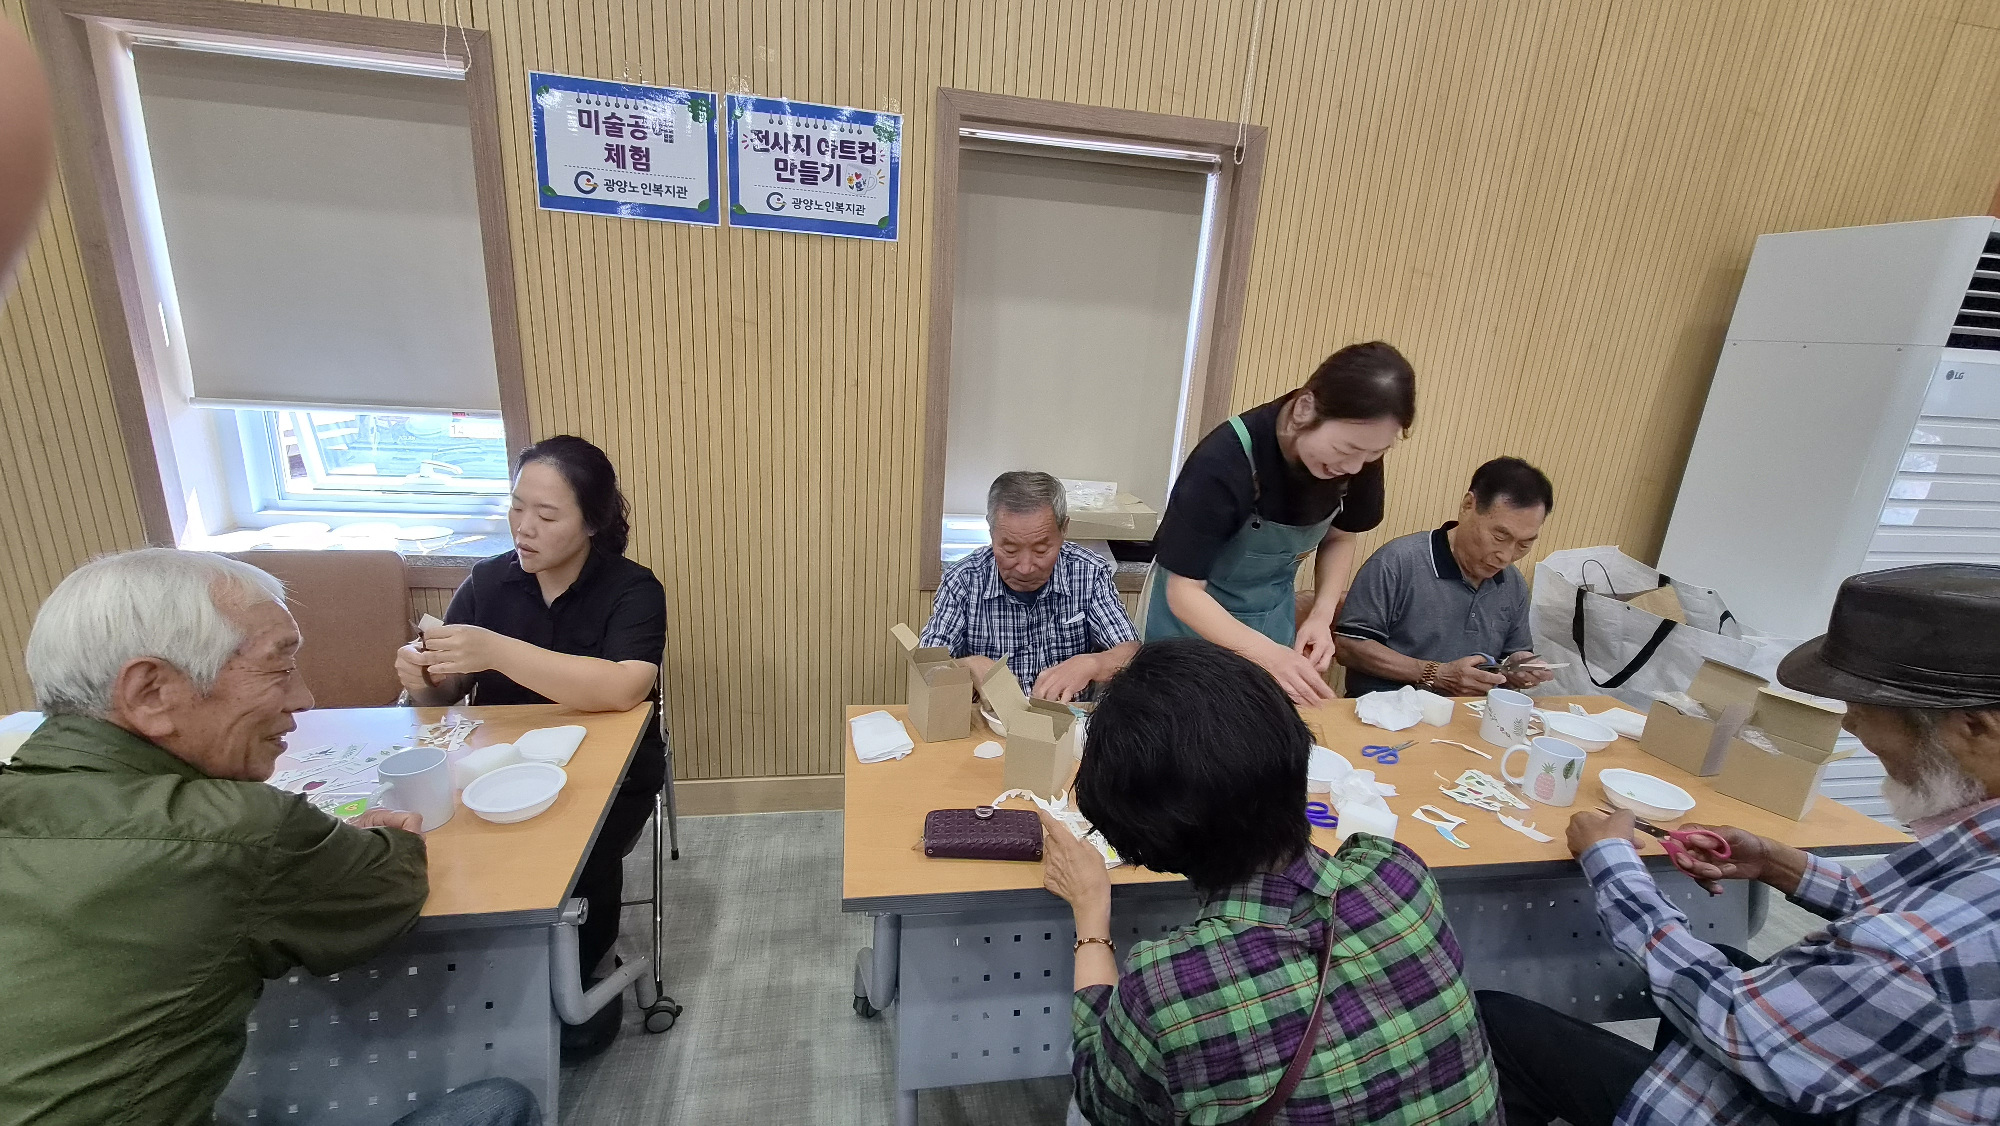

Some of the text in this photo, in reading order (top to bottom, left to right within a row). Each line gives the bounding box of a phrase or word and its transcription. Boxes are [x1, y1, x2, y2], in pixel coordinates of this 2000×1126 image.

[604, 142, 651, 173] 체험
[749, 129, 877, 165] 전사지 아트컵
[774, 157, 842, 187] 만들기
[603, 178, 689, 199] 광양노인복지관
[791, 197, 867, 217] 광양노인복지관
